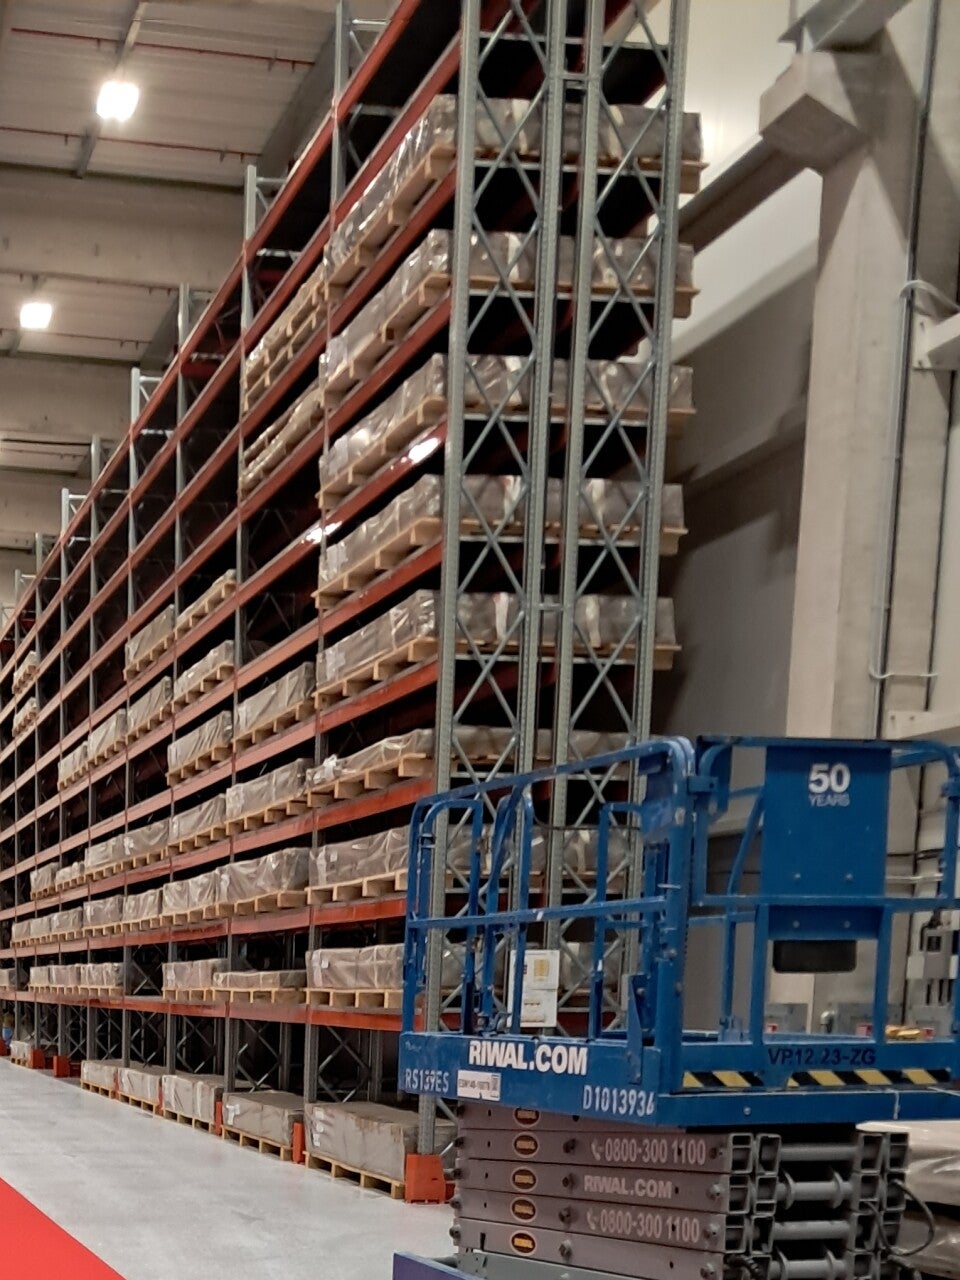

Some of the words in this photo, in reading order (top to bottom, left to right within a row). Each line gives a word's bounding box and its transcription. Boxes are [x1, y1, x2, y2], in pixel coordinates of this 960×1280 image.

[809, 762, 850, 793] 50
[809, 793, 850, 807] YEARS
[469, 1040, 588, 1075] RIWAL.COM
[583, 1085, 655, 1117] D1013936
[671, 1139, 707, 1166] 1100
[584, 1175, 673, 1199] RIWAL.COM
[666, 1216, 701, 1243] 1100
